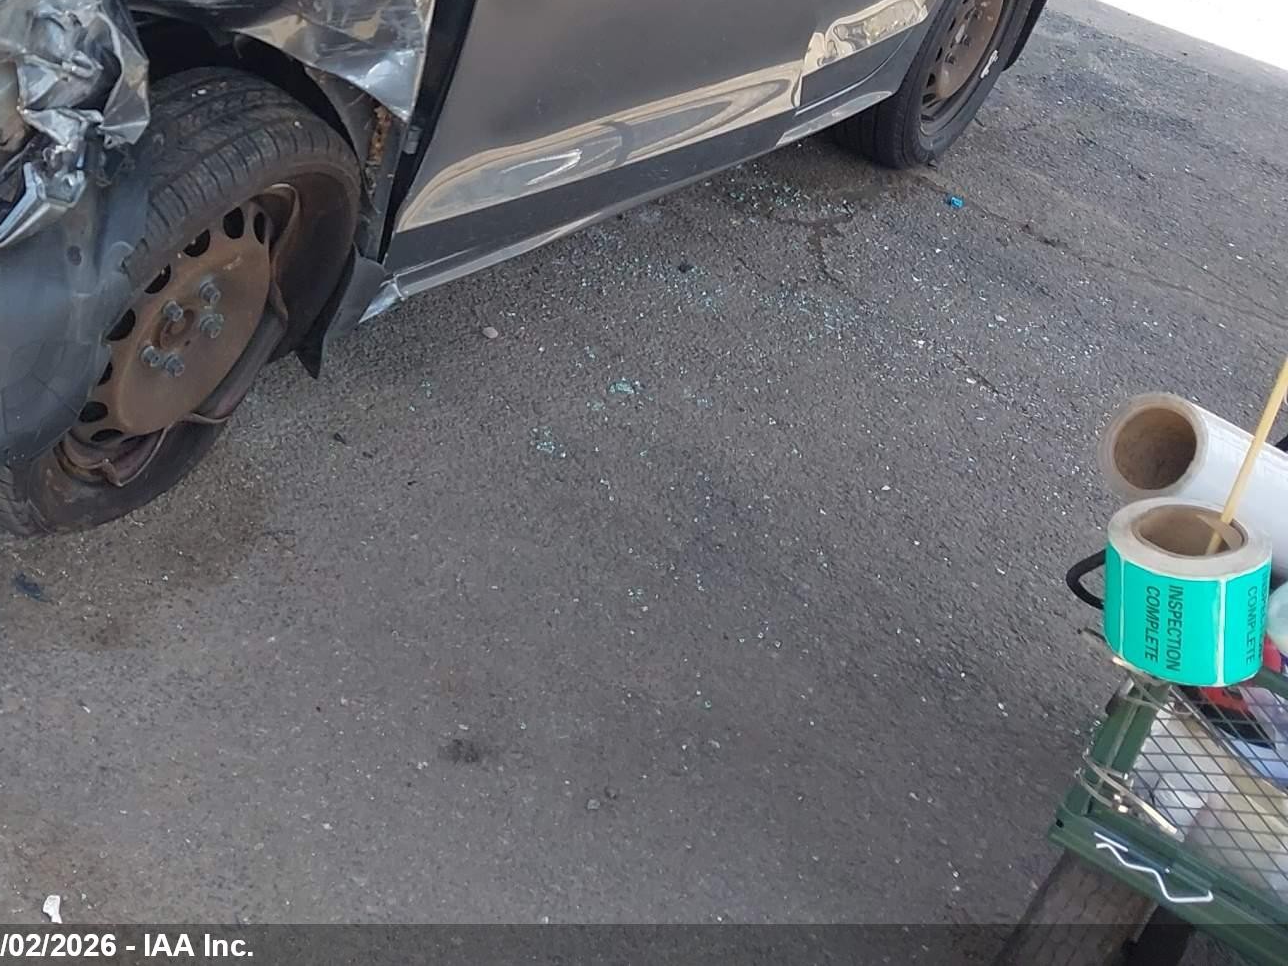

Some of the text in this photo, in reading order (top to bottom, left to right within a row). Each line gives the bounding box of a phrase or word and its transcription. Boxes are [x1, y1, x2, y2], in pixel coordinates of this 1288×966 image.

[1144, 585, 1161, 663] COMPLETE
[1166, 584, 1185, 673] INSPECTION
[1245, 585, 1259, 665] COMPLETE
